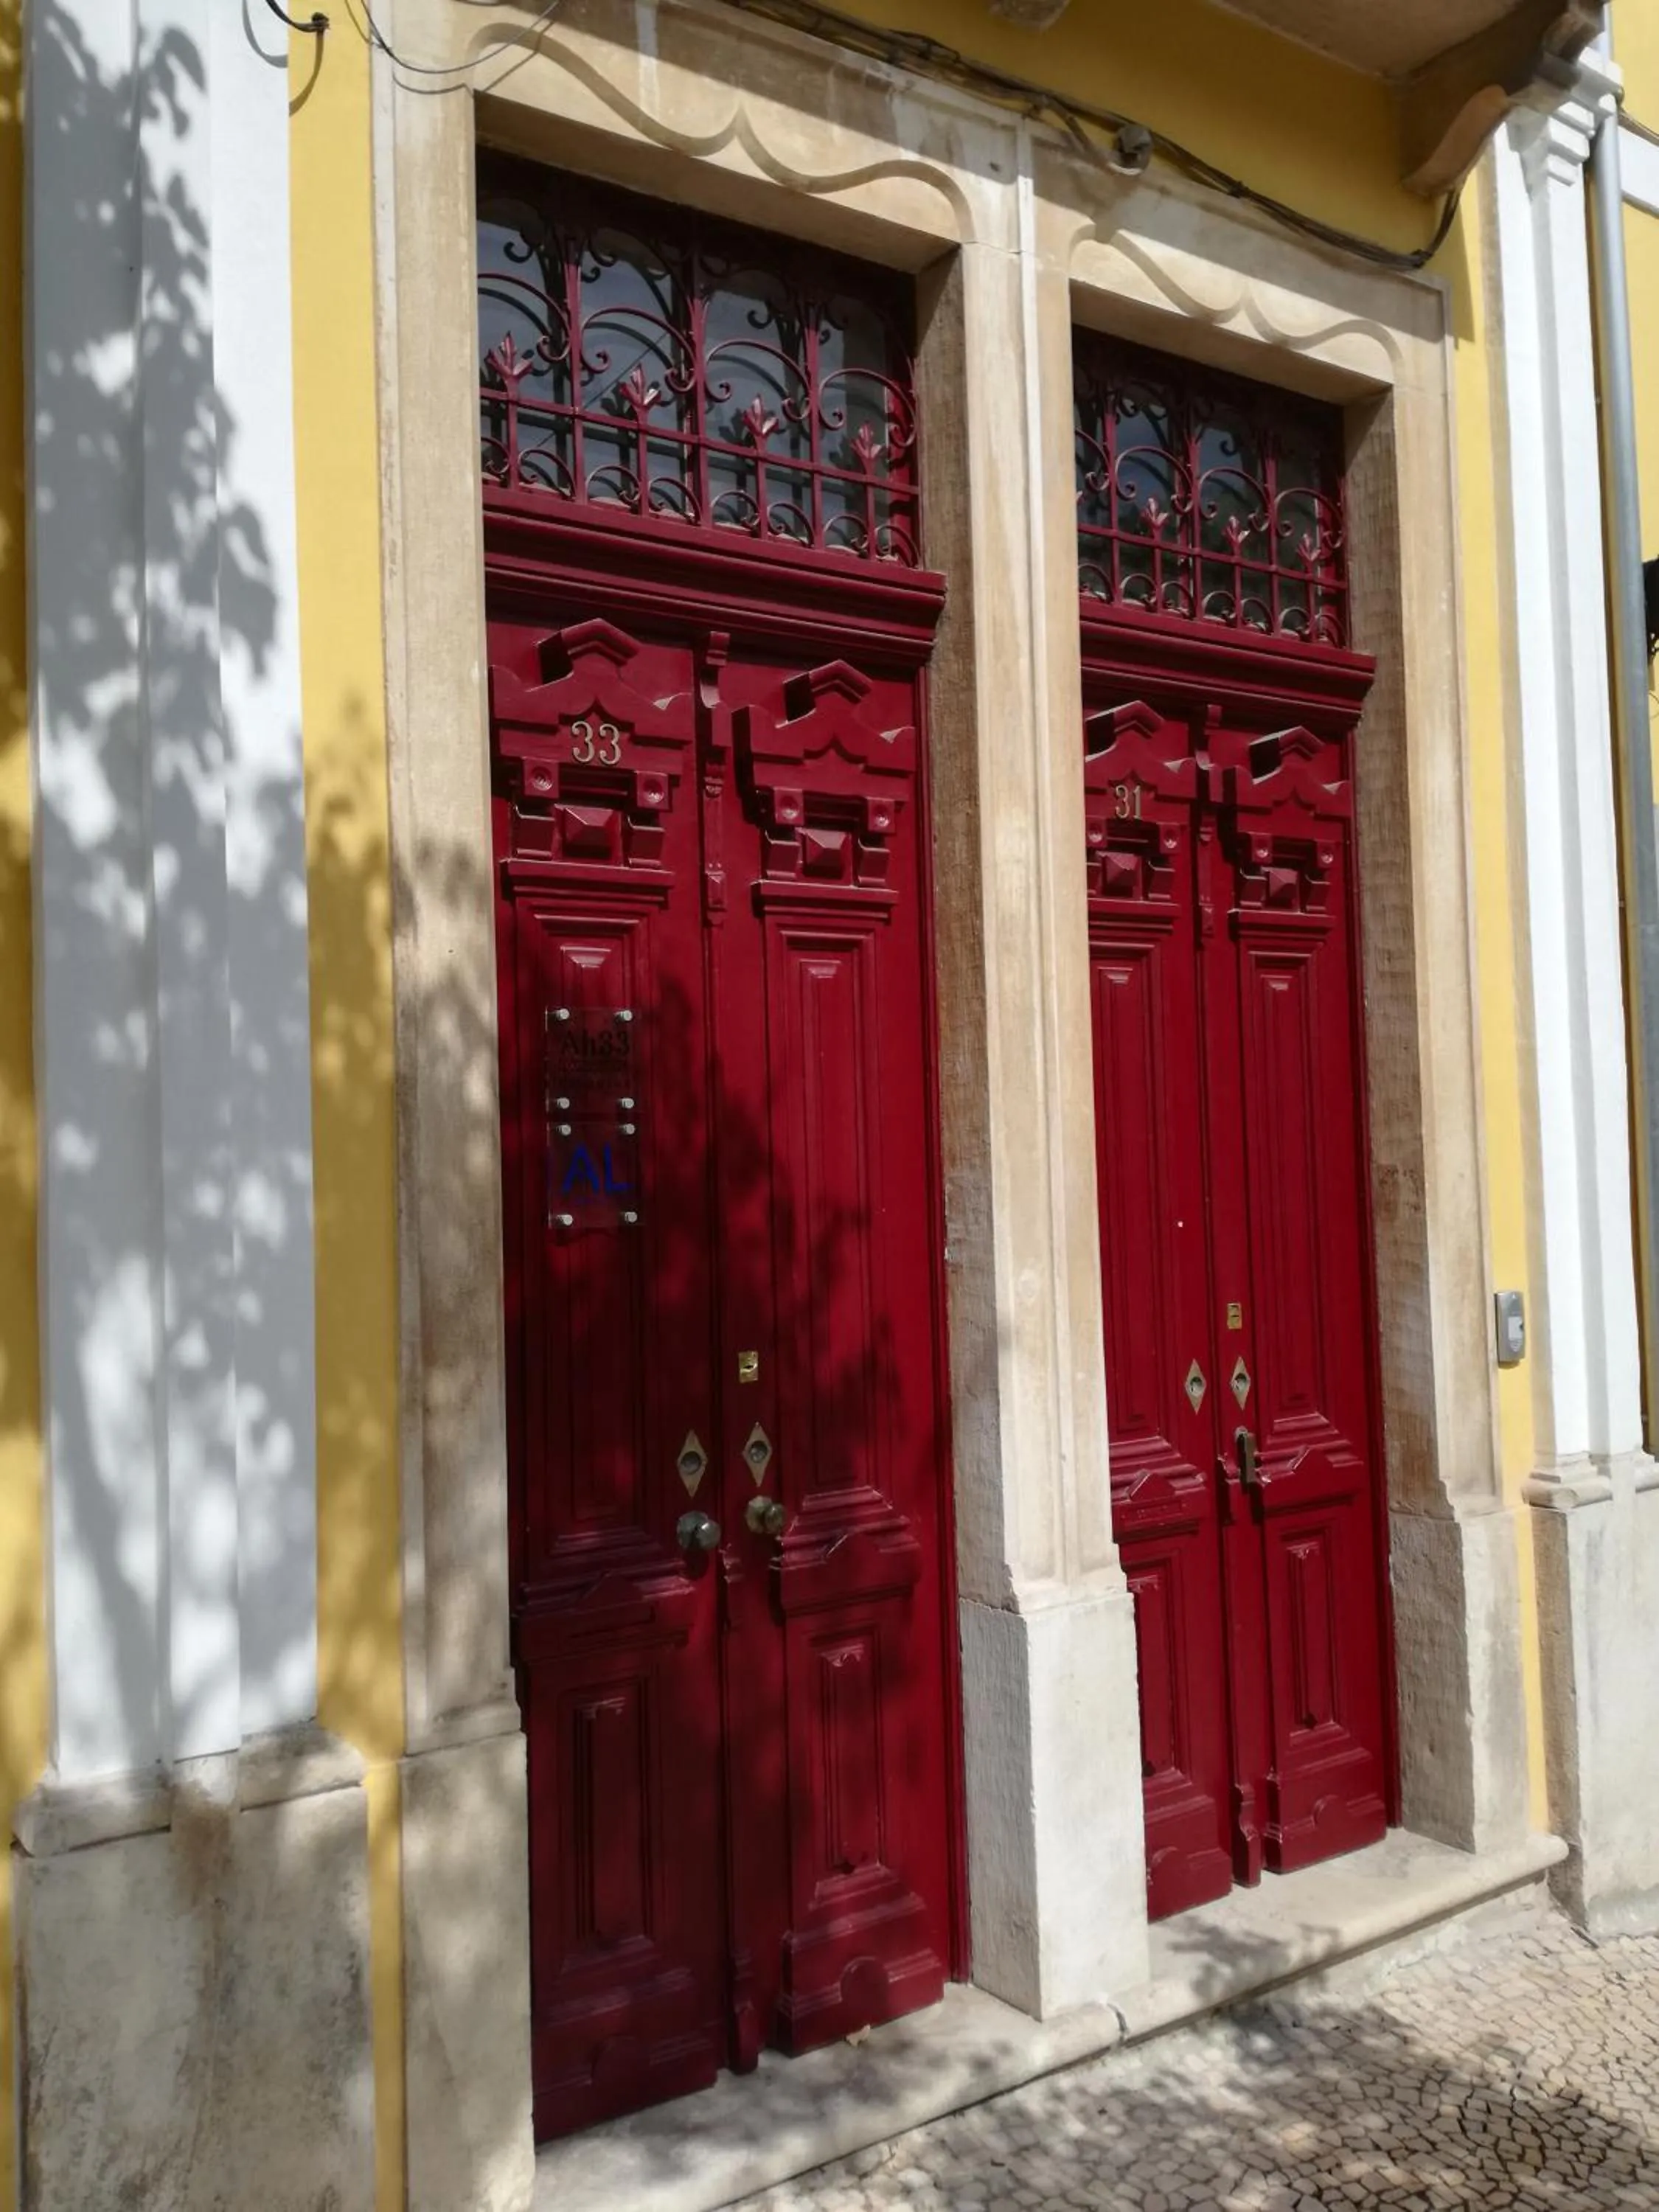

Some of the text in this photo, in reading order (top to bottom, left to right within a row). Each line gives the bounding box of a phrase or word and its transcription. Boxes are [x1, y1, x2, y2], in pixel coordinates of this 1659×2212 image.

[571, 720, 622, 765] 33
[1115, 785, 1142, 819] 31
[562, 1141, 633, 1195] AL
